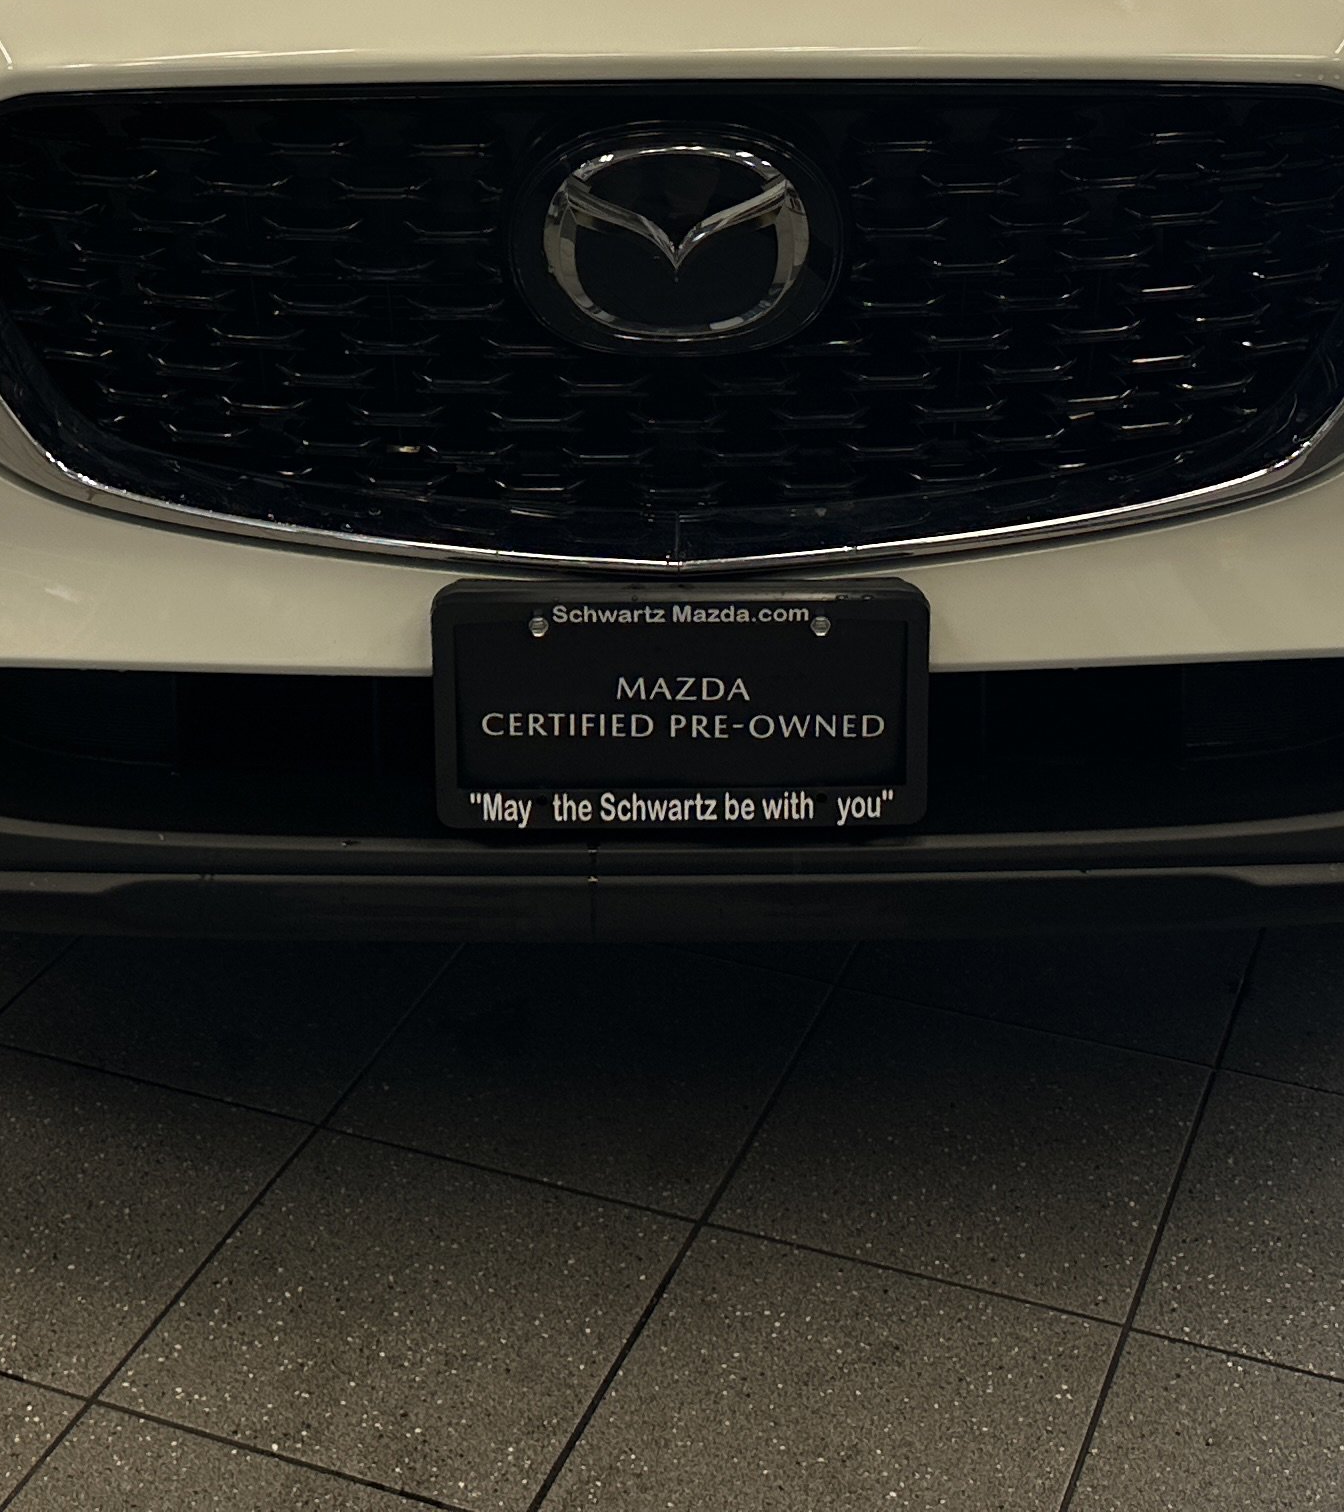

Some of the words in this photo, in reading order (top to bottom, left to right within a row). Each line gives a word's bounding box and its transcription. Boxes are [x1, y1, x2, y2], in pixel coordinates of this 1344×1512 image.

[552, 605, 666, 623] Schwartz
[672, 605, 809, 623] Mazda.com
[616, 677, 750, 701] MAZDA
[481, 712, 654, 737] CERTIFIED
[670, 714, 885, 739] PRE-OWNED
[469, 792, 532, 829] "May
[552, 793, 593, 822] the
[600, 792, 718, 822] Schwartz
[724, 791, 755, 821] be
[761, 790, 814, 820] with
[836, 789, 894, 826] you"
